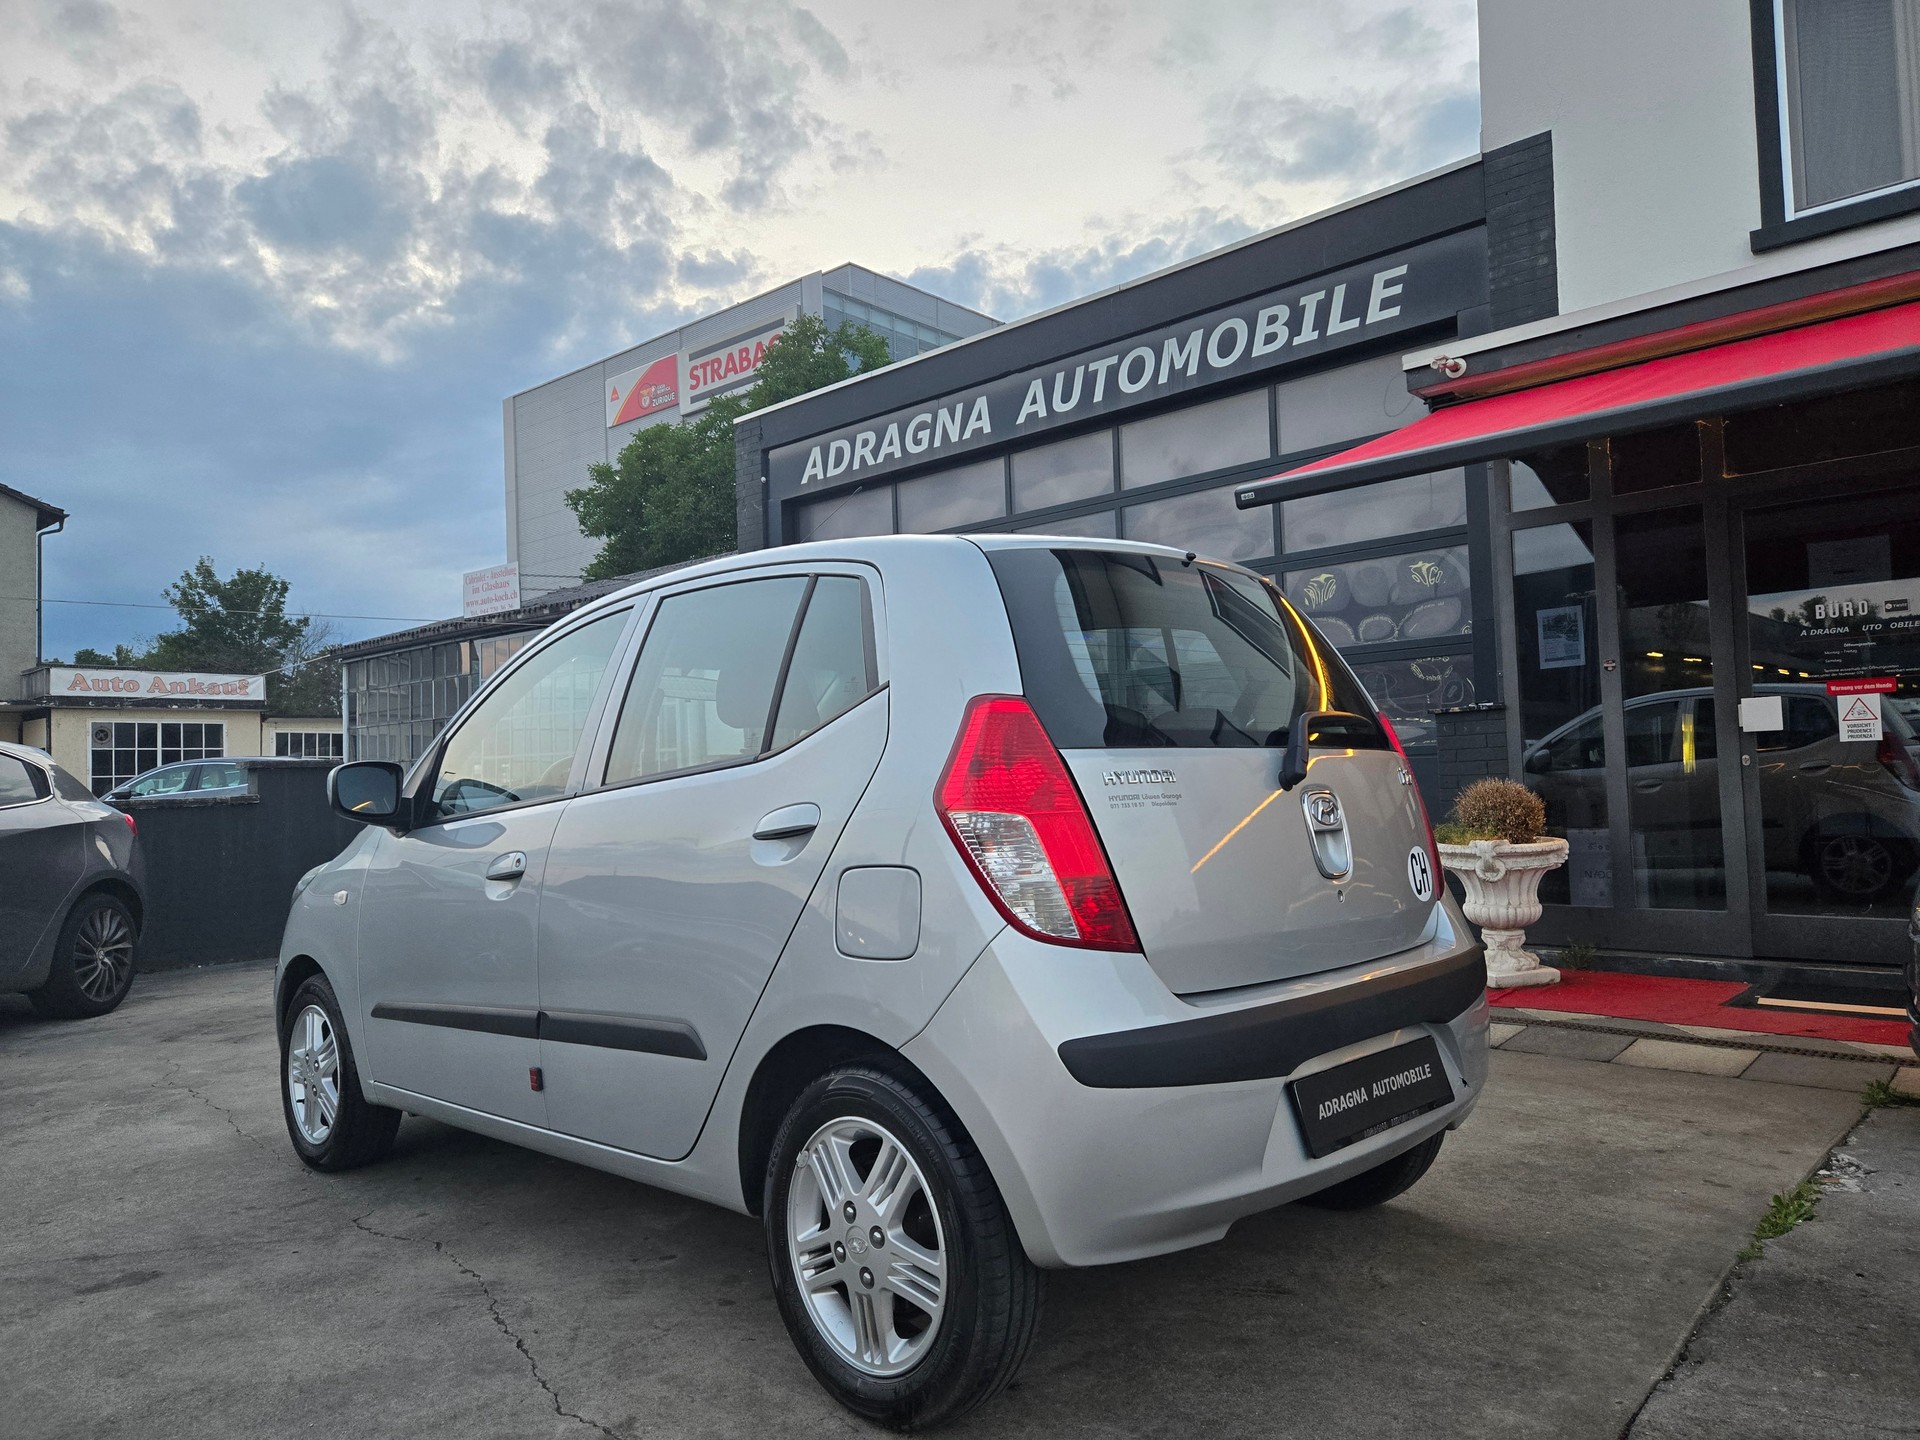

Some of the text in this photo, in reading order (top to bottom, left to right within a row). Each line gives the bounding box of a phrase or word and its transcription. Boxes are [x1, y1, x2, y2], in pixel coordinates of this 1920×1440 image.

[801, 263, 1408, 485] ADRAGNA AUTOMOBILE
[652, 392, 675, 407] ZURIQUE
[482, 580, 510, 592] Glashaus
[465, 590, 518, 608] www.auto-koch.ch
[1815, 600, 1869, 620] BÜRO
[67, 673, 250, 696] Auto Ankauf
[1102, 769, 1177, 786] HYUNDAI
[1108, 794, 1140, 802] HYUNDAI
[1161, 792, 1182, 800] Garage
[1410, 852, 1431, 896] CH
[1319, 1063, 1432, 1121] ADRAGNA AUTOMOBILE
